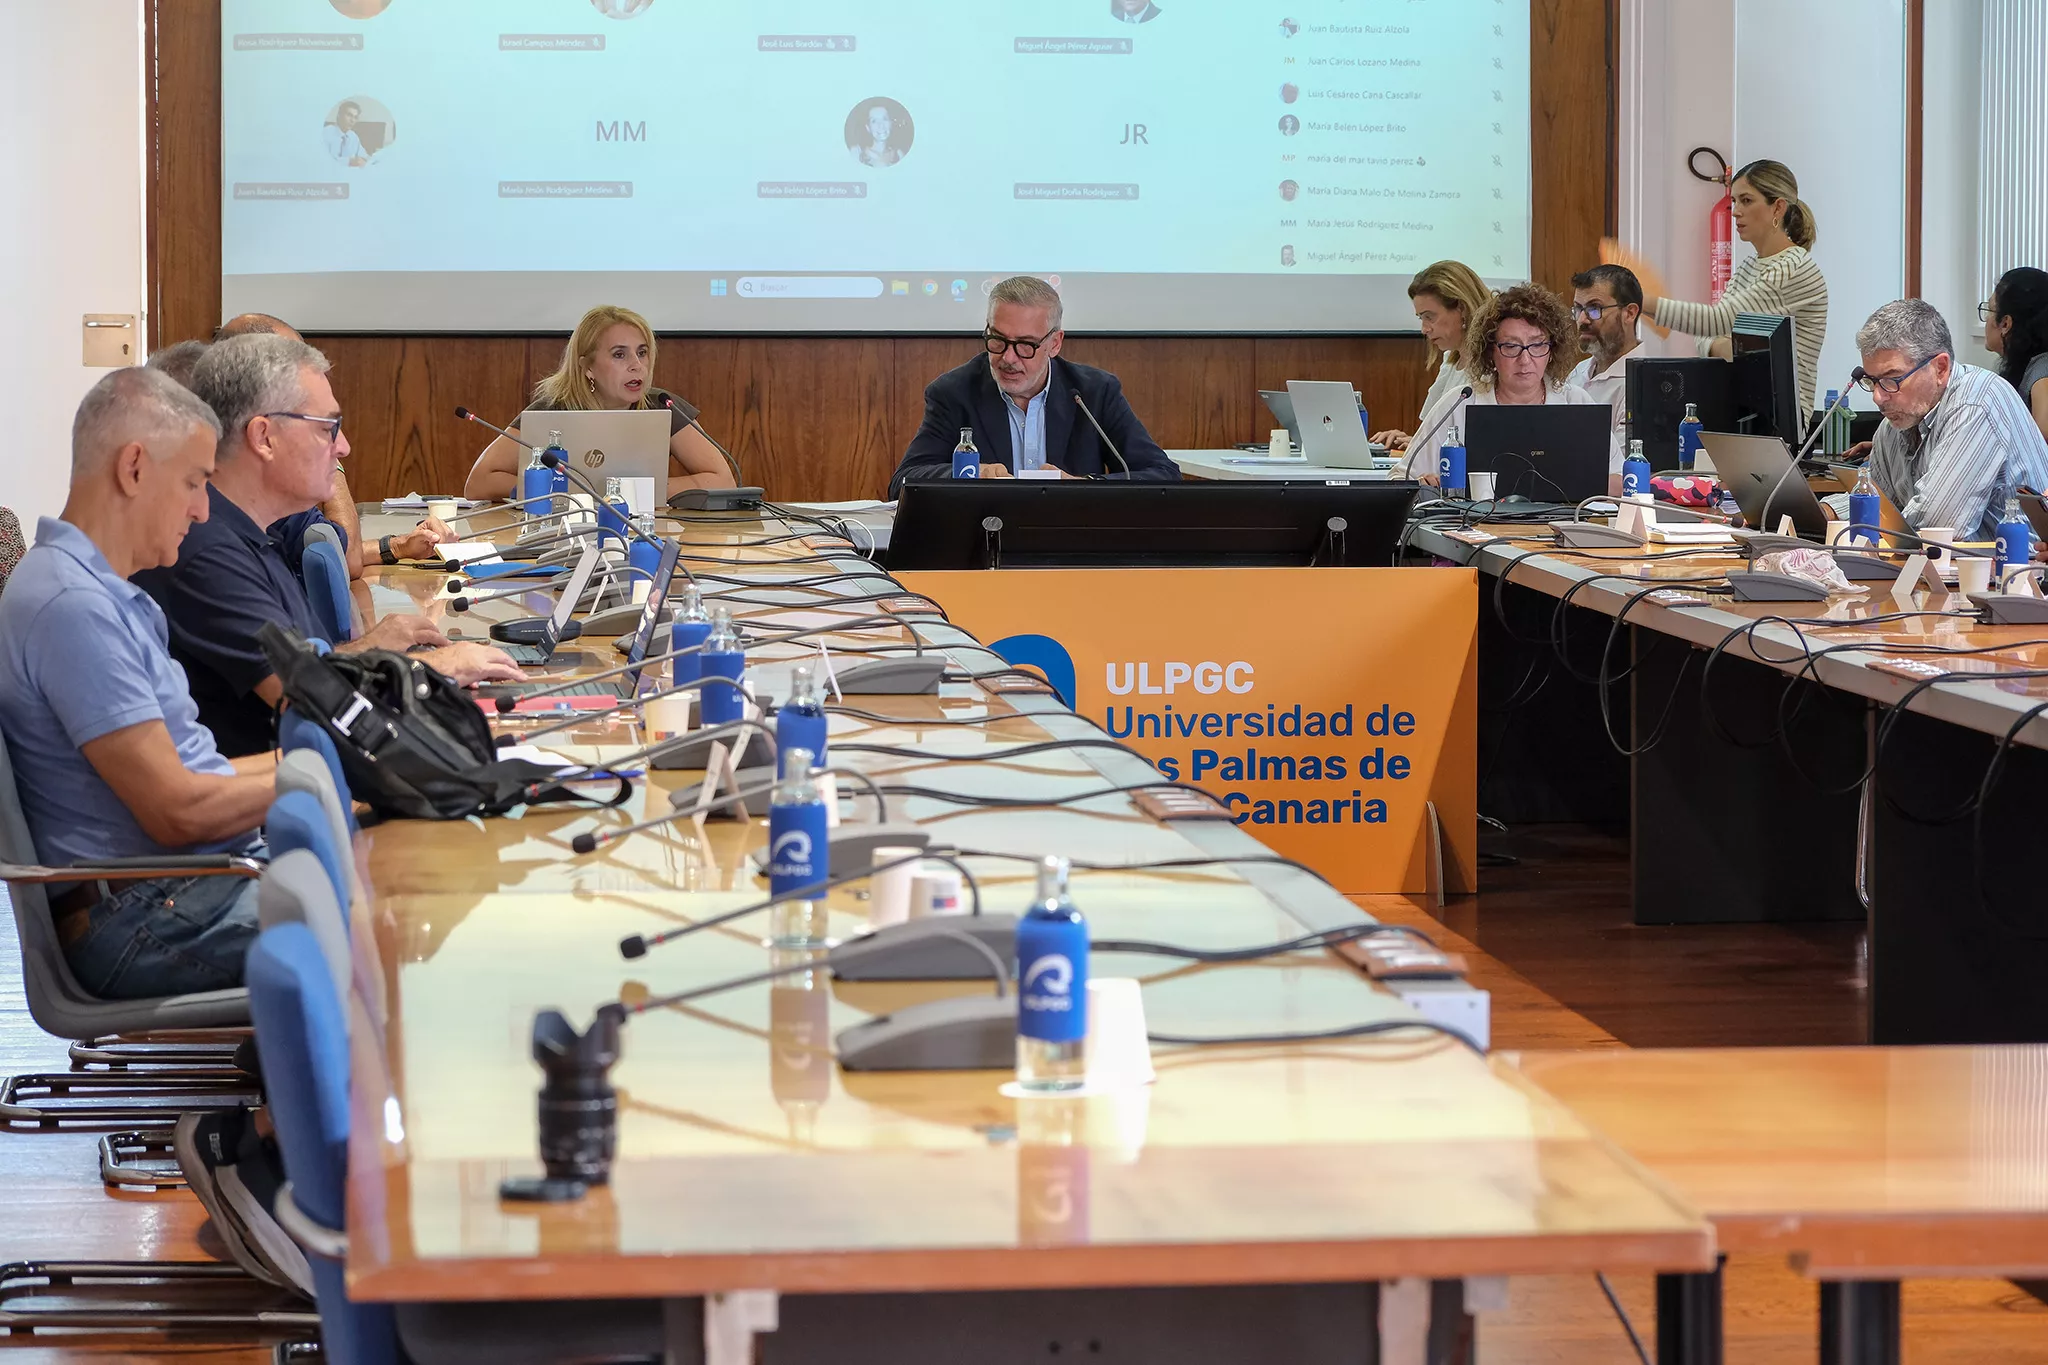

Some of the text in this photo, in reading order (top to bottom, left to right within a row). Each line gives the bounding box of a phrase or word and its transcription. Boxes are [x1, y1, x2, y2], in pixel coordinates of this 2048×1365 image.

[1308, 24, 1410, 34] Juan Bautista Ruiz Alzola
[1308, 57, 1421, 67] Juan Carlos Lozano Medina
[1308, 90, 1324, 98] Luis
[596, 120, 648, 142] MM
[1119, 122, 1149, 145] JR
[1387, 124, 1407, 133] Brito
[1333, 154, 1347, 164] del
[1334, 187, 1357, 196] Diana
[1360, 188, 1381, 198] Malo
[1384, 189, 1396, 198] De
[1398, 190, 1426, 199] Molina
[1428, 190, 1461, 200] Zamora
[1280, 220, 1297, 228] MM
[1402, 221, 1434, 231] Medina
[1307, 252, 1336, 262] Miguel
[760, 282, 789, 292] Buscar
[585, 449, 604, 469] hp
[1106, 661, 1254, 695] ULPGC
[1106, 704, 1416, 739] Universidad de
[1192, 748, 1348, 781] Palmas
[1359, 748, 1411, 780] de
[1222, 790, 1388, 824] Canaria
